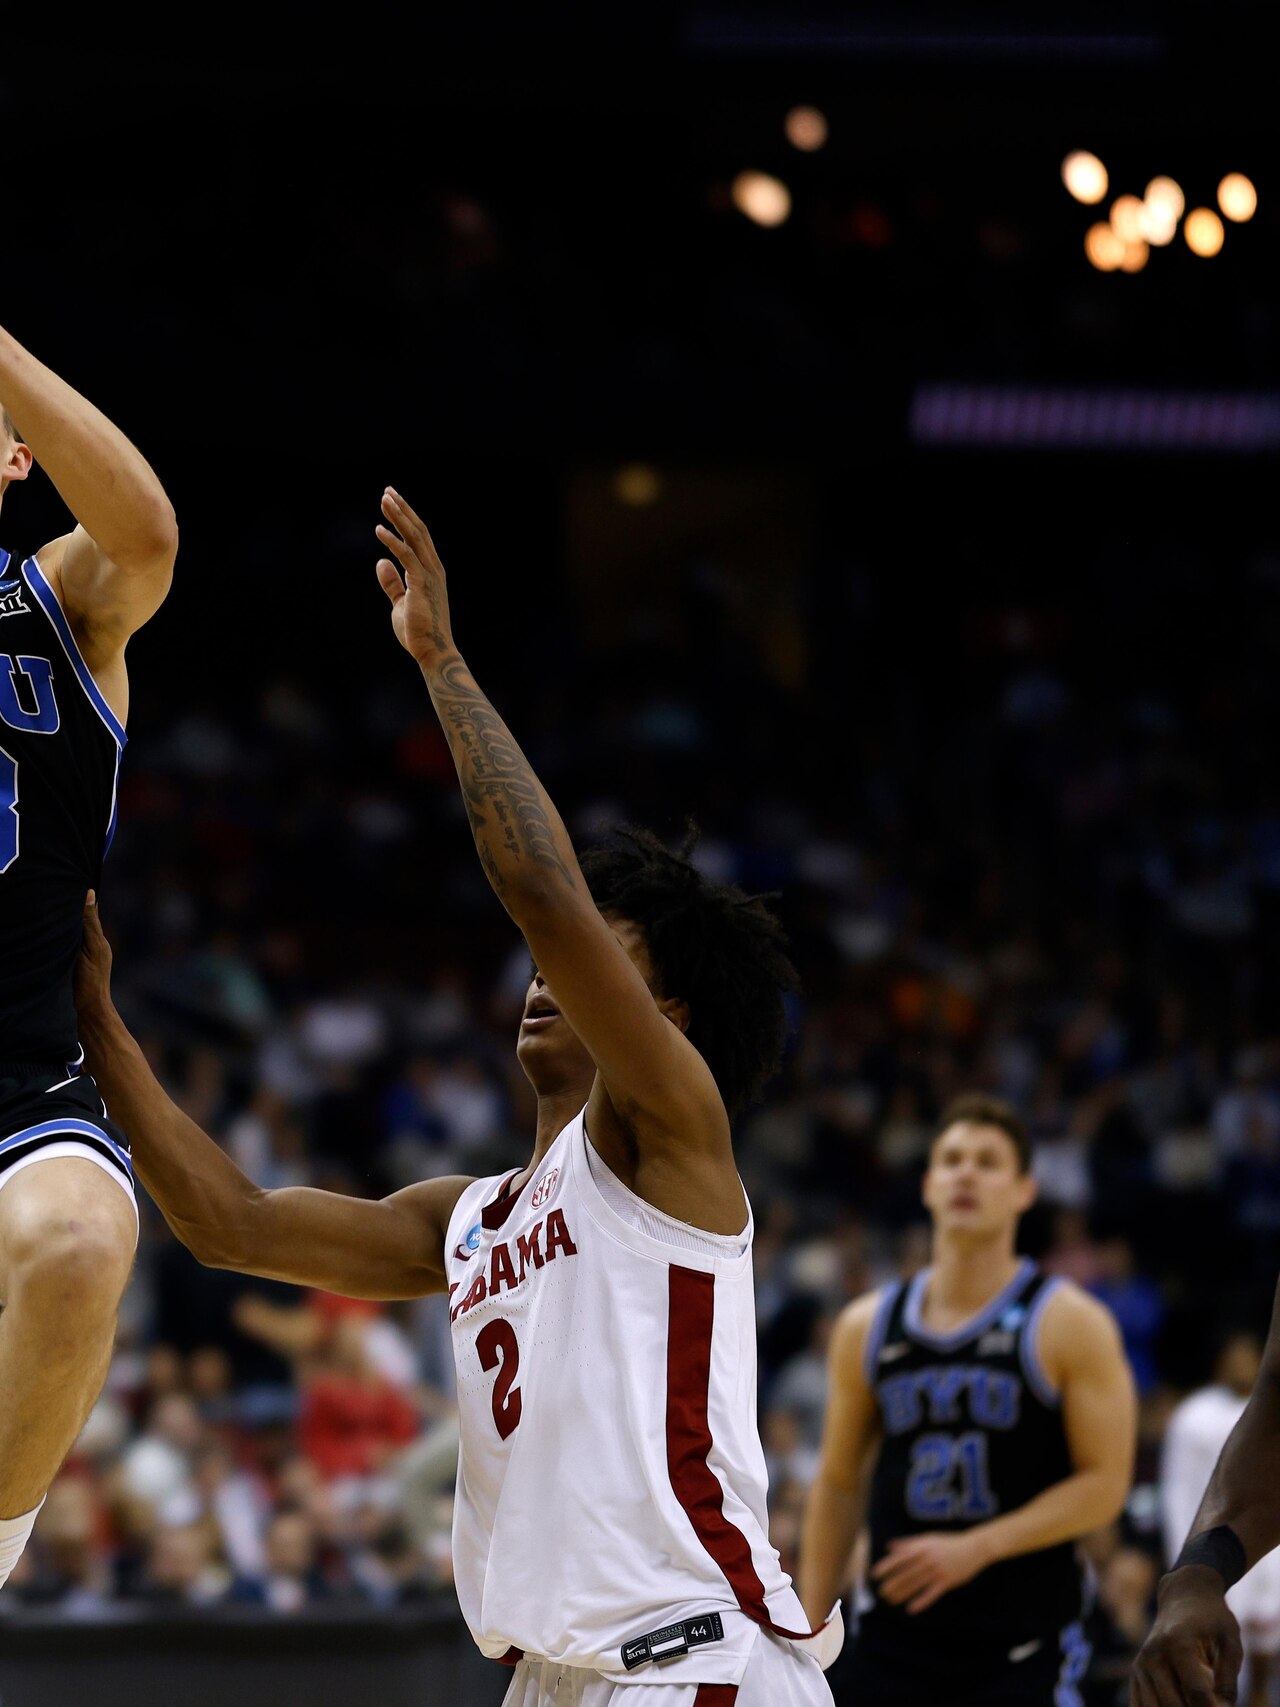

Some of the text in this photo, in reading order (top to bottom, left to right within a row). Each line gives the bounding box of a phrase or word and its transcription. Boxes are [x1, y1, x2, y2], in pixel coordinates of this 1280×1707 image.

[475, 1318, 523, 1441] 2
[879, 1366, 1021, 1435] BYU
[905, 1432, 998, 1520] 21
[690, 1625, 707, 1637] 44
